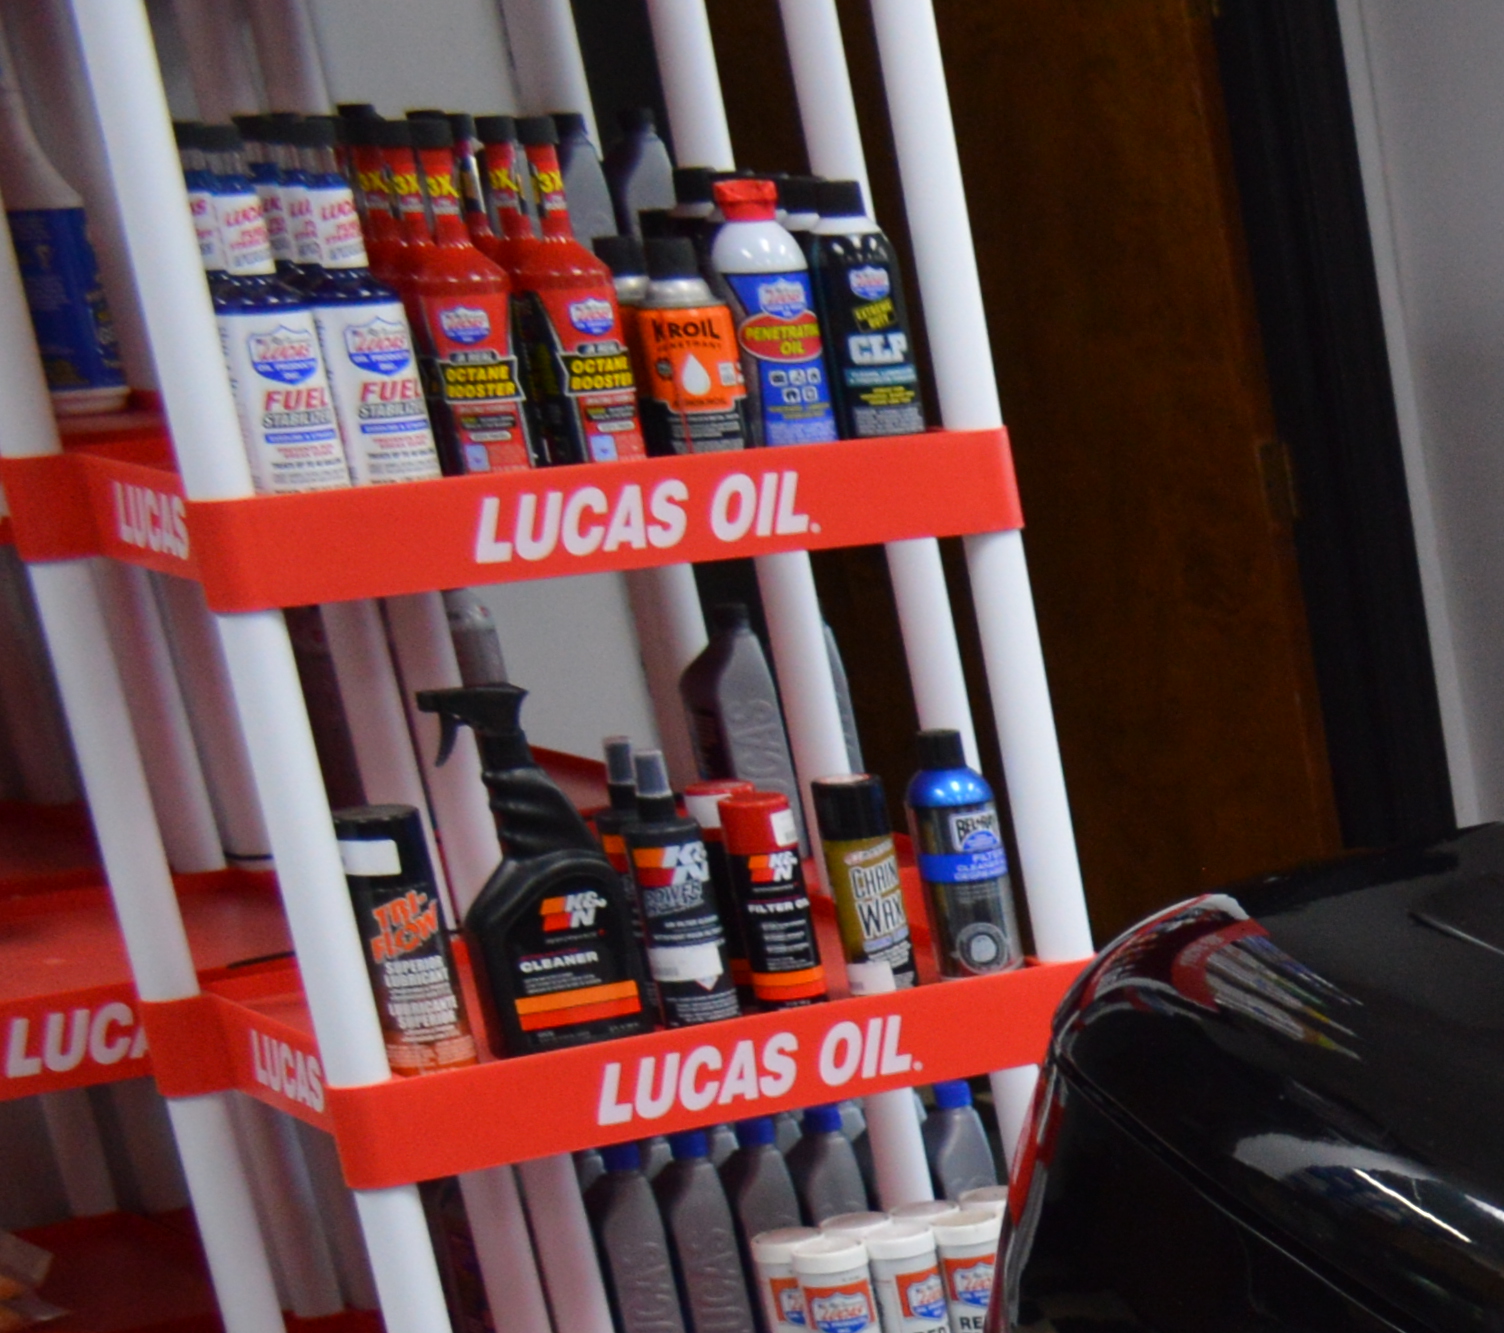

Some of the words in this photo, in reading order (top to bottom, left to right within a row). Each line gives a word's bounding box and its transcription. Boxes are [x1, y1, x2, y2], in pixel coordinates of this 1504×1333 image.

[653, 319, 722, 343] KROIL
[780, 340, 806, 356] OIL
[848, 332, 908, 365] CLP
[446, 365, 511, 383] OCTANE
[263, 387, 328, 413] FUEL
[360, 379, 422, 403] FUEL
[446, 381, 517, 399] BOOSTER
[112, 480, 190, 561] LUCAS
[475, 479, 690, 564] LUCAS
[710, 470, 811, 543] OIL
[850, 855, 900, 900] CHAIN
[747, 900, 794, 914] FILTER
[856, 890, 906, 938] WAX
[518, 951, 599, 974] CLEANER
[5, 1001, 149, 1079] LUC
[250, 1028, 326, 1114] LUCAS
[597, 1031, 799, 1126] LUCAS
[818, 1014, 913, 1087] OIL
[959, 1314, 984, 1331] RE
